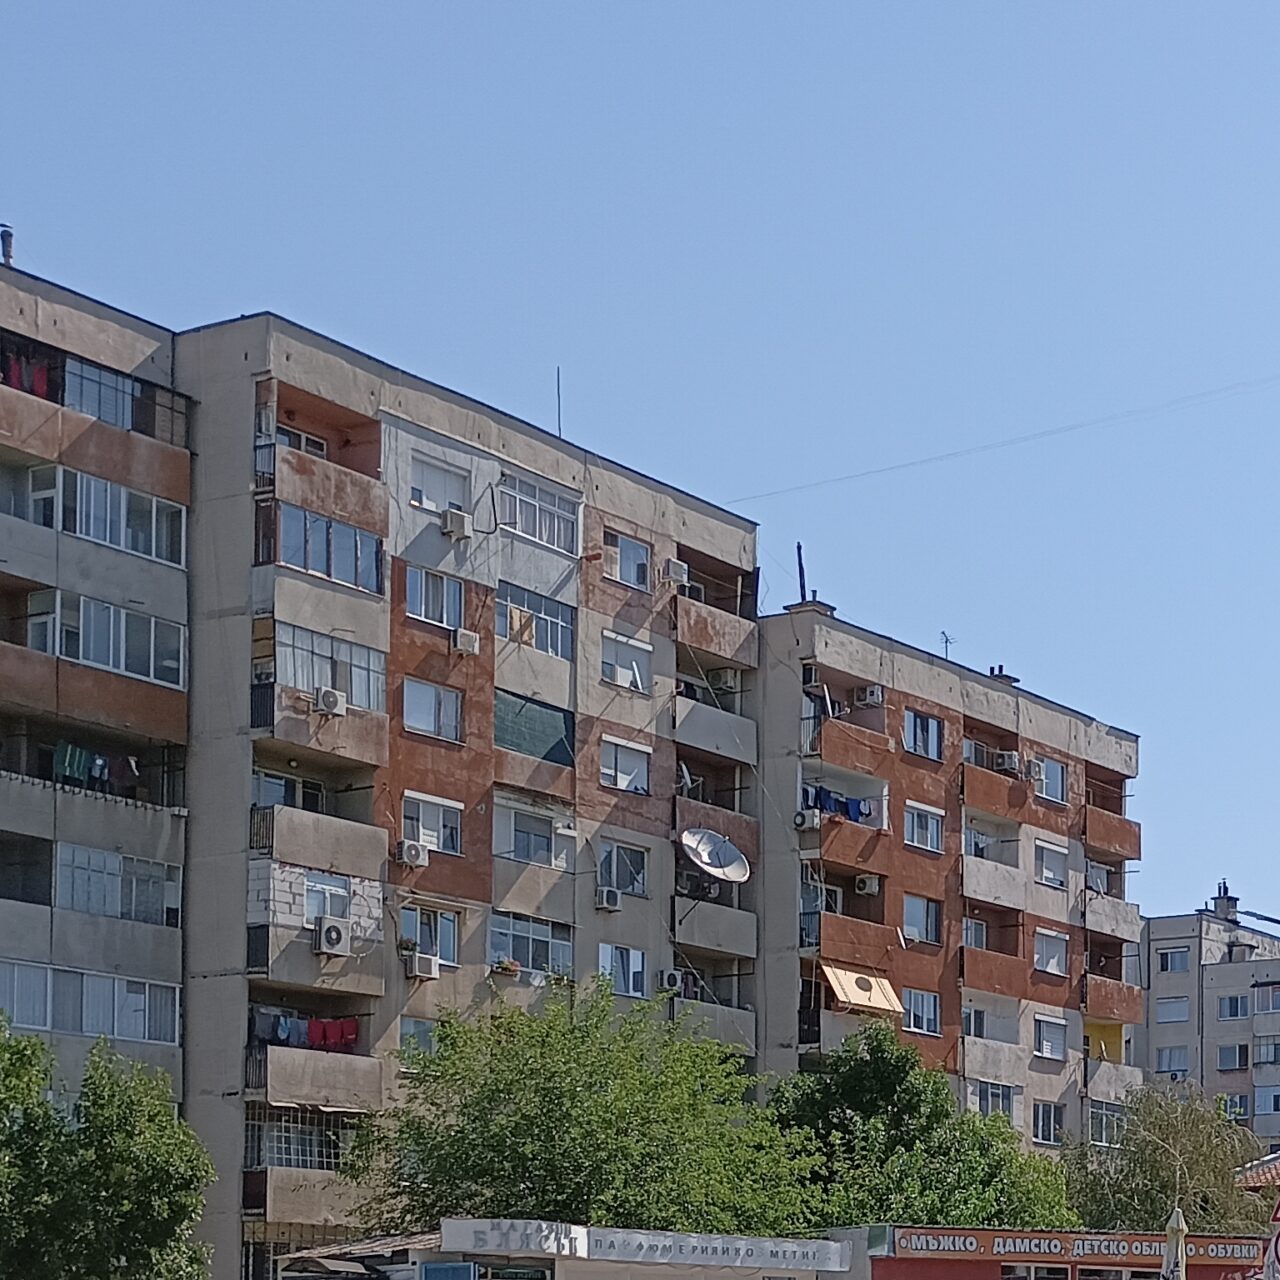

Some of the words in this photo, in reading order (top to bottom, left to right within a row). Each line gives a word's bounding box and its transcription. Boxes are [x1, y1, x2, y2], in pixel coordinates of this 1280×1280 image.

[993, 1237, 1065, 1255] ДАМСКО,
[1072, 1239, 1129, 1257] ДЕТСКО
[1131, 1240, 1196, 1257] ОБЛЕО
[1207, 1243, 1258, 1258] ОБУВКИ
